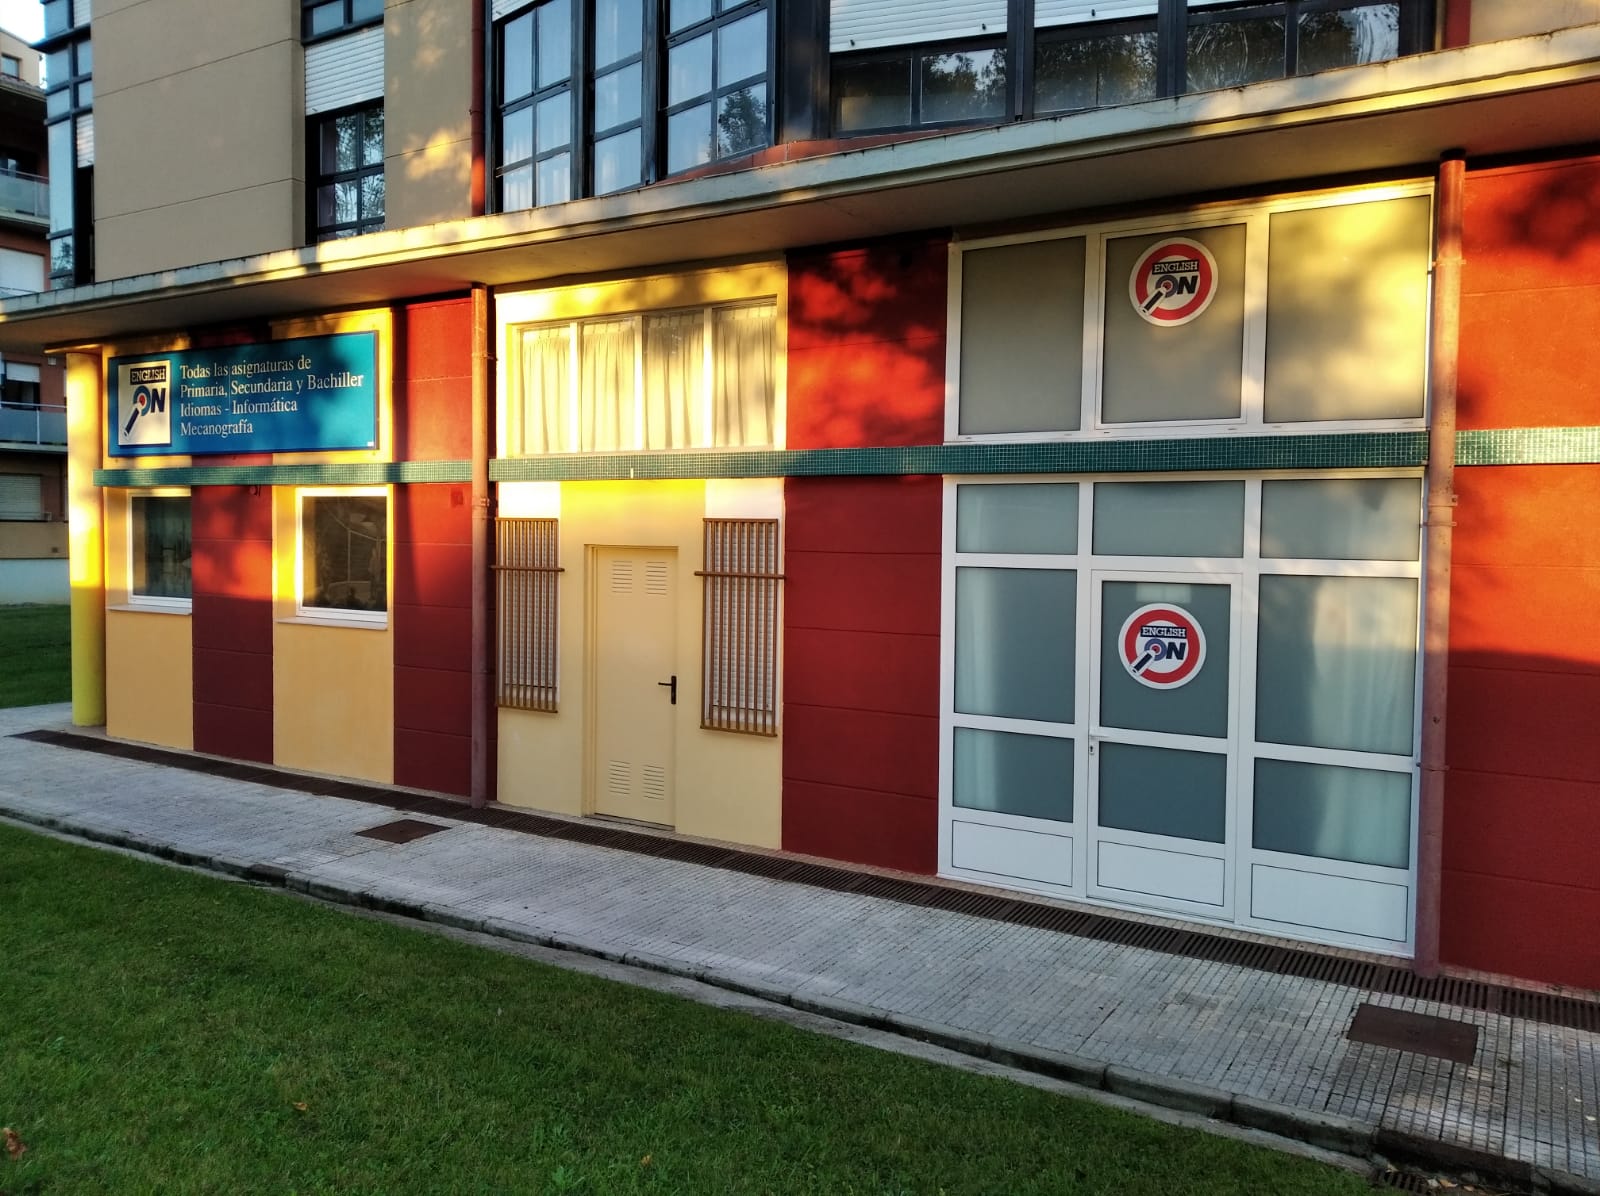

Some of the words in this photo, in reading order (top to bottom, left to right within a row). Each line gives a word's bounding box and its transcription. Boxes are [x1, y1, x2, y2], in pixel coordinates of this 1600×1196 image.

[1154, 261, 1199, 273] ENGLISH
[1155, 275, 1199, 298] ON
[131, 368, 166, 383] ENGLISH
[180, 364, 210, 379] Todas
[214, 362, 228, 377] las
[231, 360, 294, 378] asignaturas
[298, 355, 312, 370] de
[181, 383, 228, 398] Primaria,
[231, 377, 293, 395] Secundaria
[296, 380, 304, 395] y
[307, 371, 364, 390] Bachiller
[133, 386, 166, 416] ON
[181, 402, 222, 417] Idiomas
[232, 397, 298, 415] Informática
[181, 419, 253, 438] Mecanografía
[1142, 626, 1187, 638] ENGLISH
[1144, 638, 1187, 661] ON
